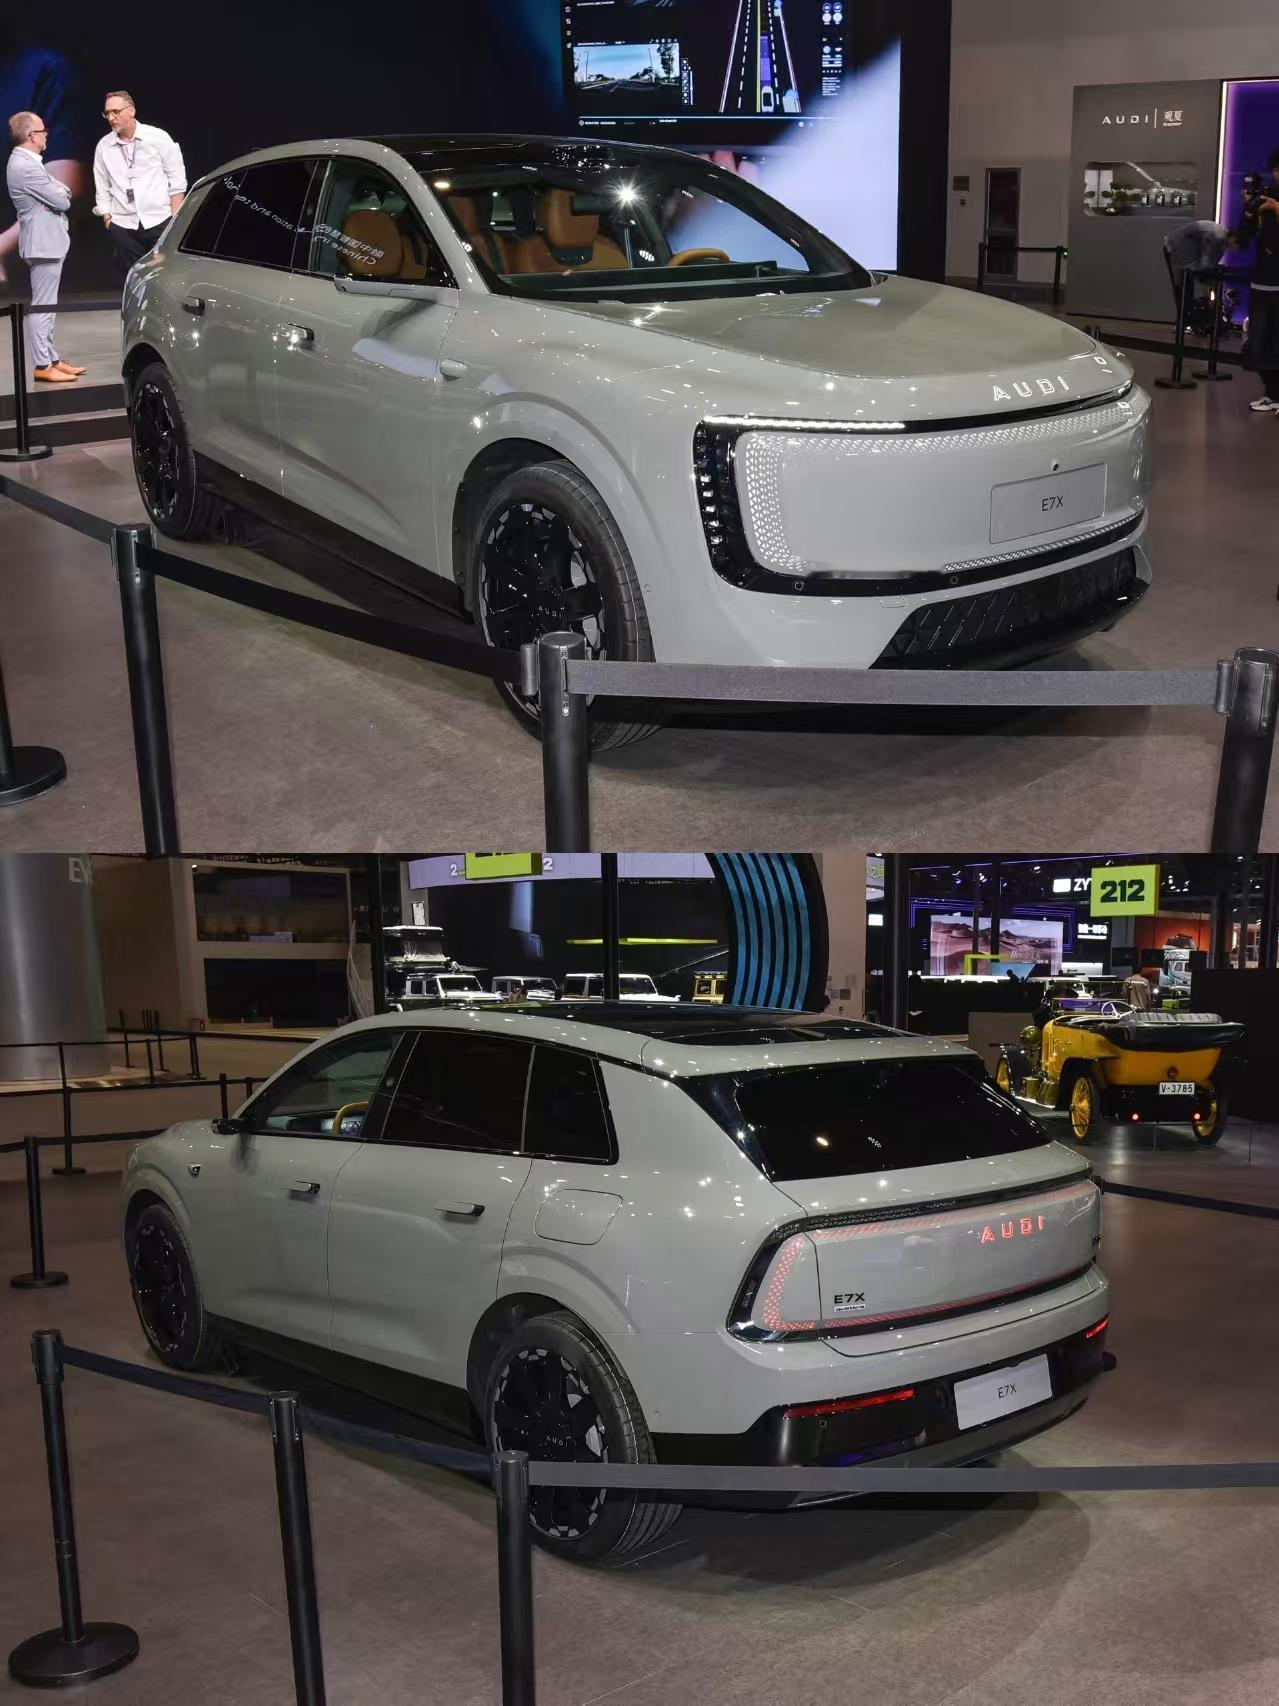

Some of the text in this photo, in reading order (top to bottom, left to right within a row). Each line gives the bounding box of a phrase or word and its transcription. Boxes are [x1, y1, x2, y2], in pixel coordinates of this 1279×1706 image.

[1102, 114, 1149, 124] AUDI
[993, 376, 1069, 401] AUDI
[1042, 495, 1064, 511] E7X
[1100, 879, 1145, 903] 212
[981, 1215, 1044, 1243] AUDI
[834, 1292, 865, 1304] E7X
[998, 1382, 1017, 1399] E7X
